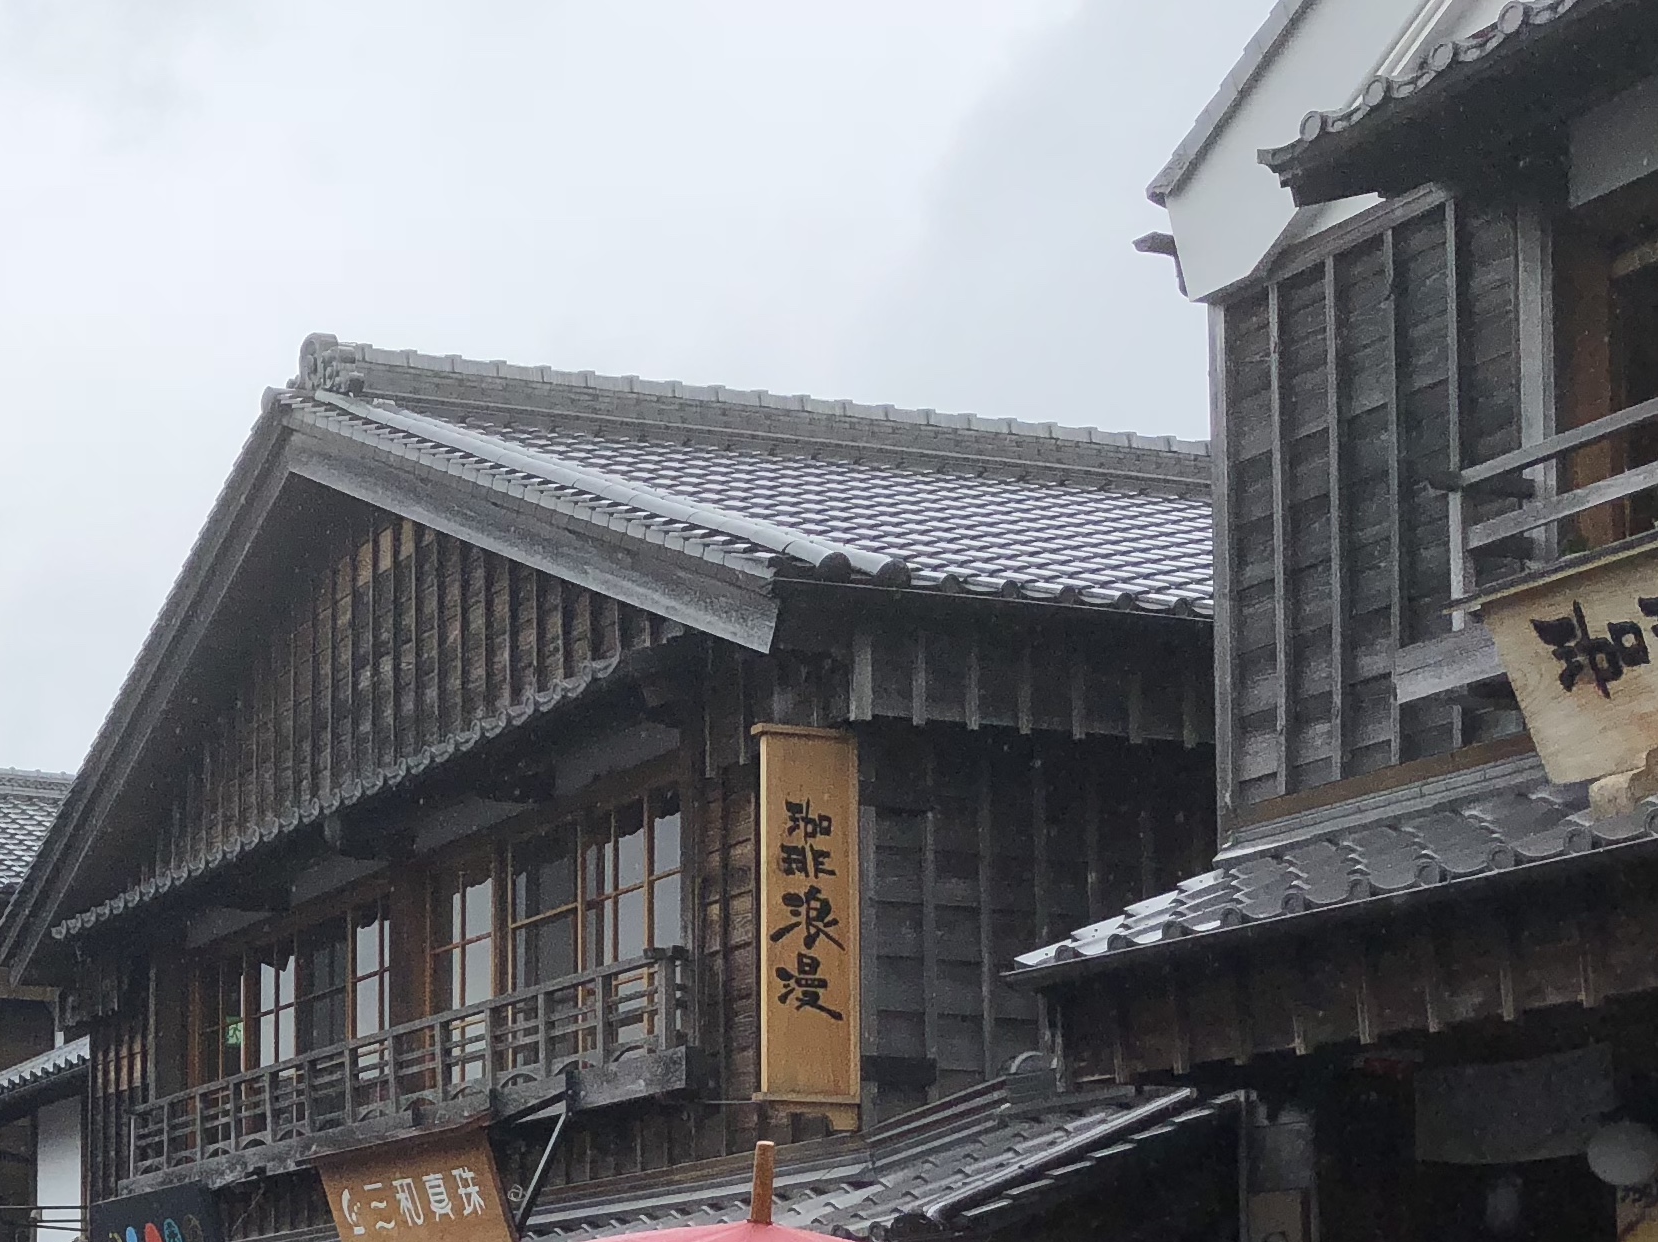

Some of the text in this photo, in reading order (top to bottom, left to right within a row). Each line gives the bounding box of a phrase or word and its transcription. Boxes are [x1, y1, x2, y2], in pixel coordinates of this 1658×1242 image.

[1529, 596, 1658, 699] 珈
[769, 797, 846, 1022] 珈琲浪漫
